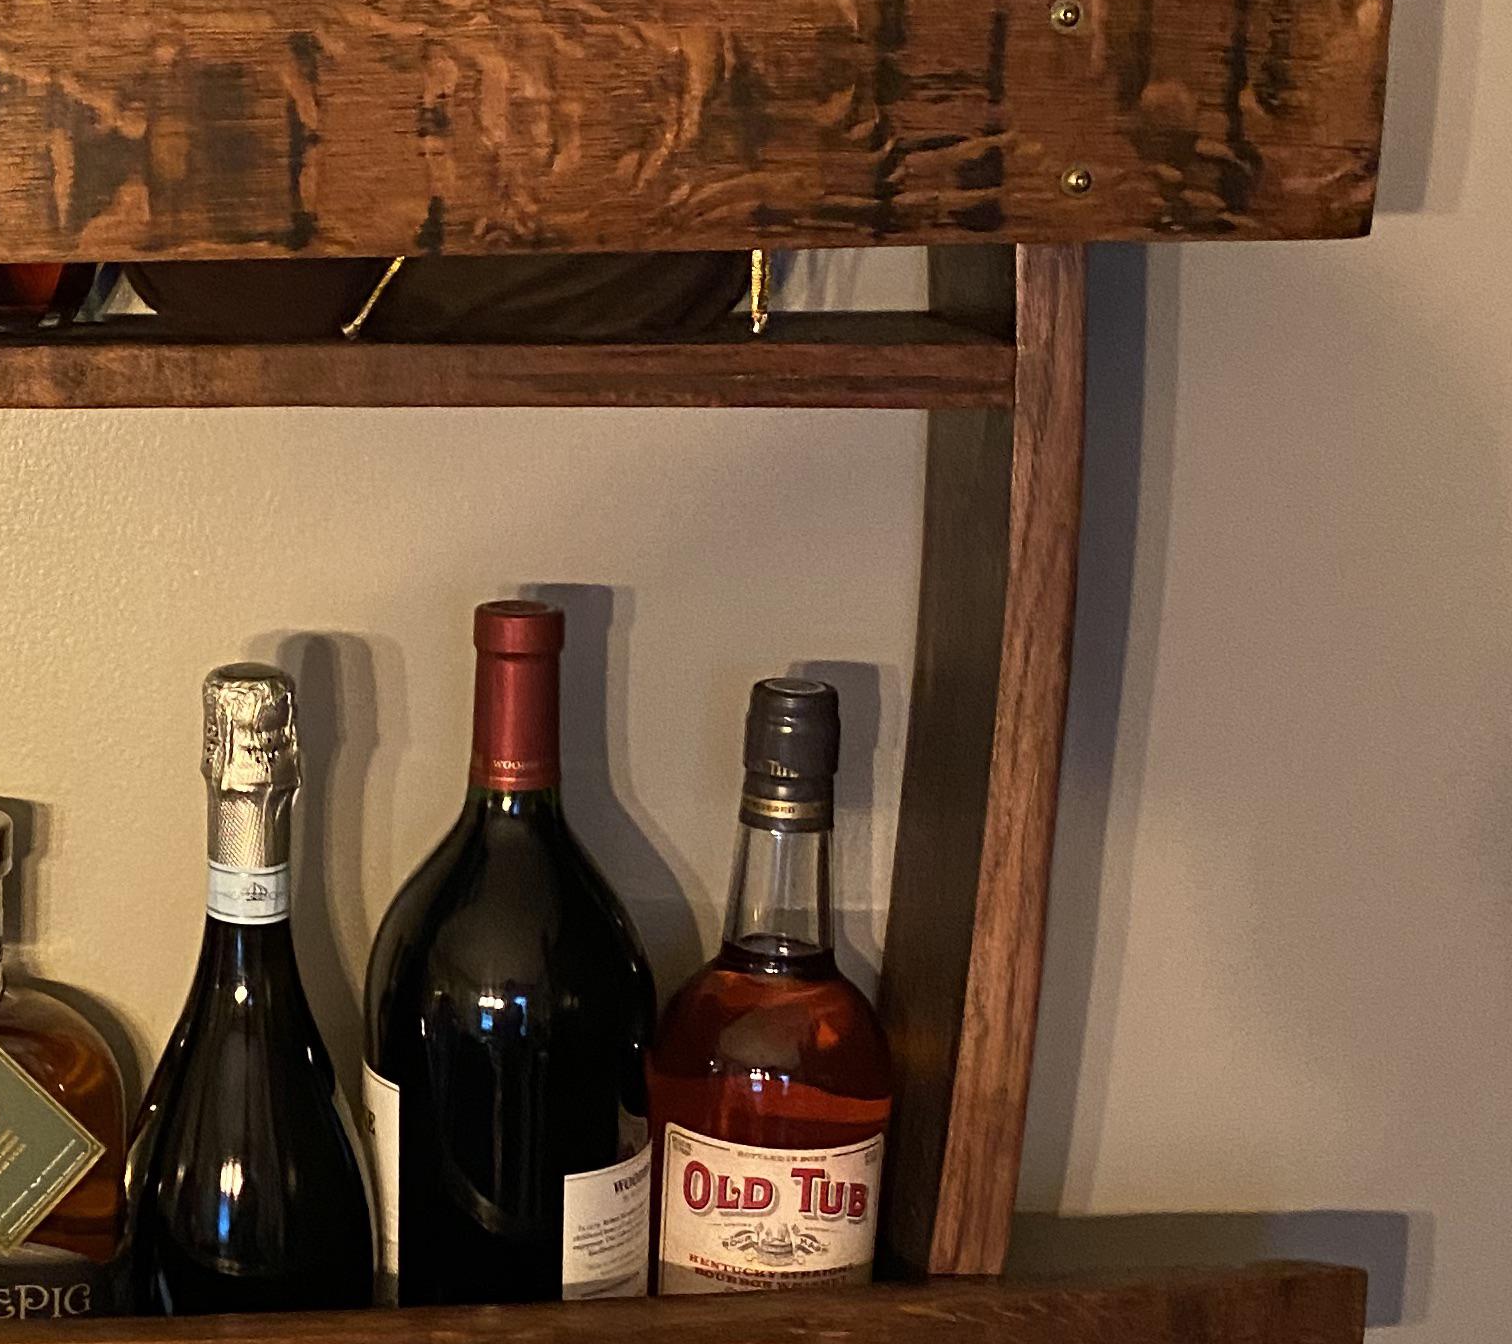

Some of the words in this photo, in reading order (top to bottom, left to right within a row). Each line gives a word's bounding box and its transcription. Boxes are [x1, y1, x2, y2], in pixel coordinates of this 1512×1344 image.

[682, 1159, 775, 1212] OLD
[790, 1166, 870, 1219] TUB
[688, 1252, 777, 1279] KENTUCKY
